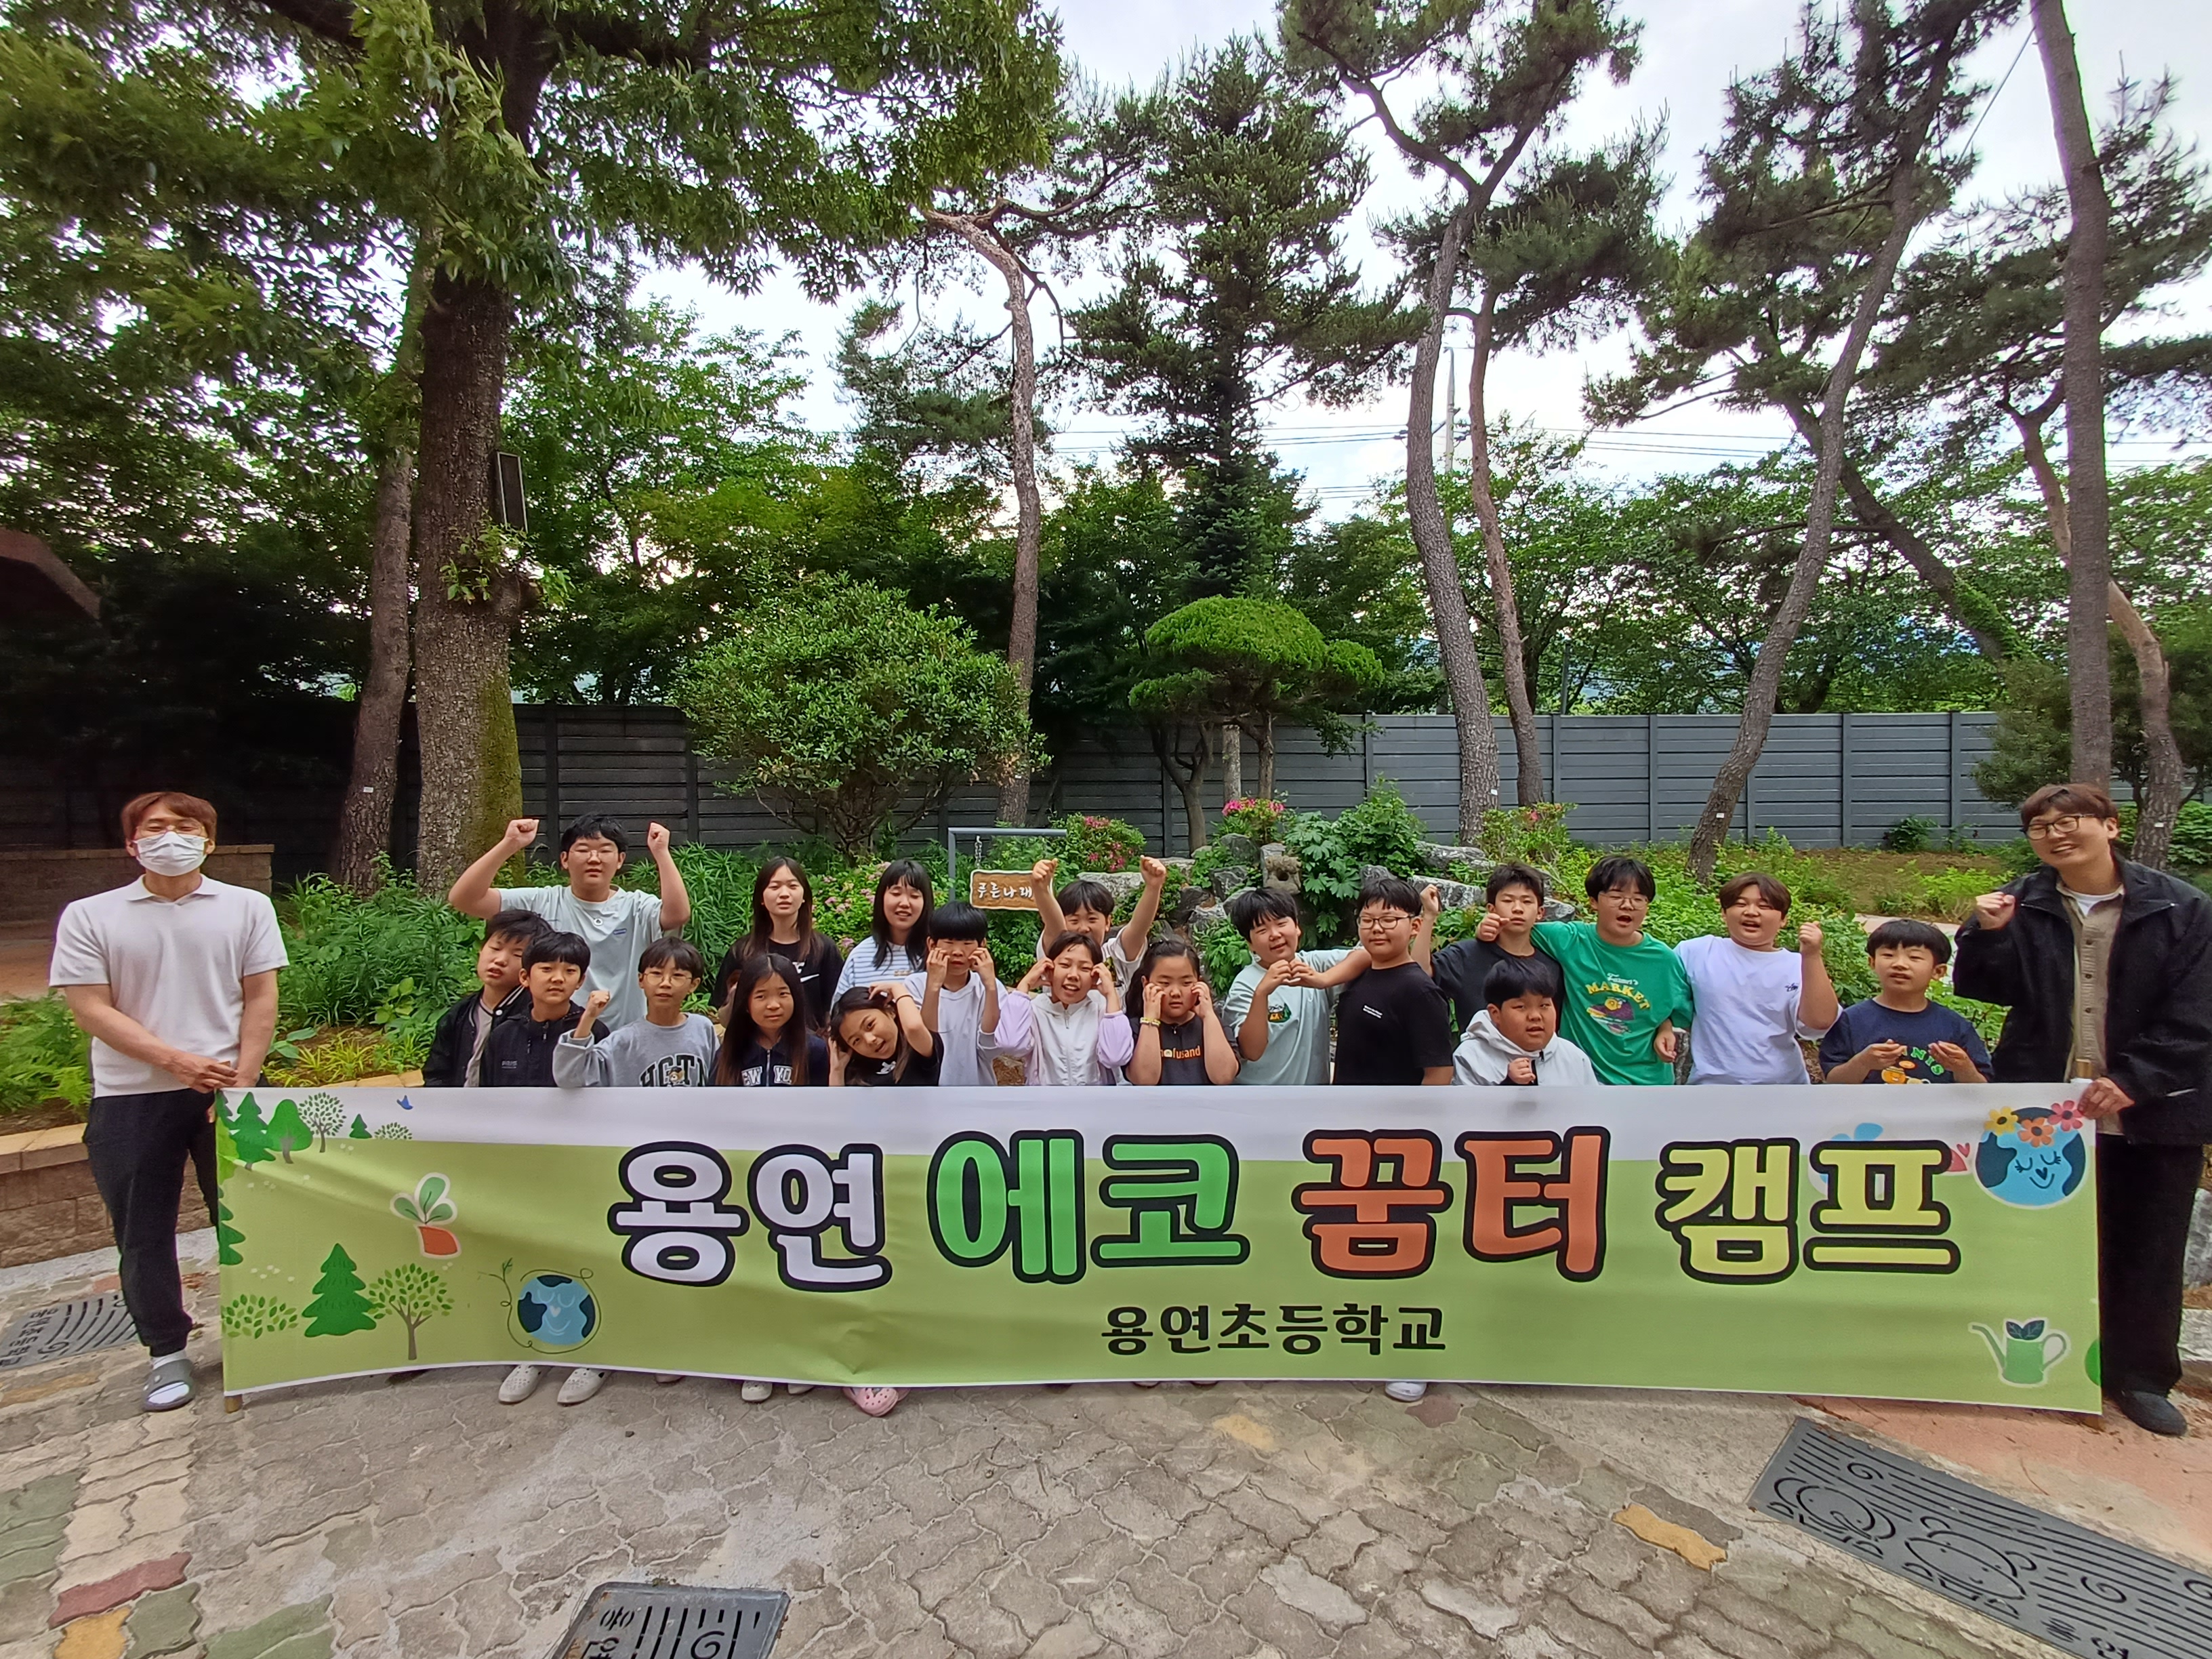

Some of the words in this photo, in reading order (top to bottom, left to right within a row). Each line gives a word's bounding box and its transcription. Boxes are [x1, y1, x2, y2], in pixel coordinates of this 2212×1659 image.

[1584, 981, 1650, 1009] MARKET
[741, 1065, 764, 1087] EW
[773, 1065, 794, 1085] YO
[607, 1141, 893, 1292] 용연
[926, 1128, 1250, 1285] 에코
[1291, 1126, 1611, 1283] 꿈터
[1655, 1137, 1961, 1285] 캠프
[1101, 1302, 1447, 1355] 용연초등학교
